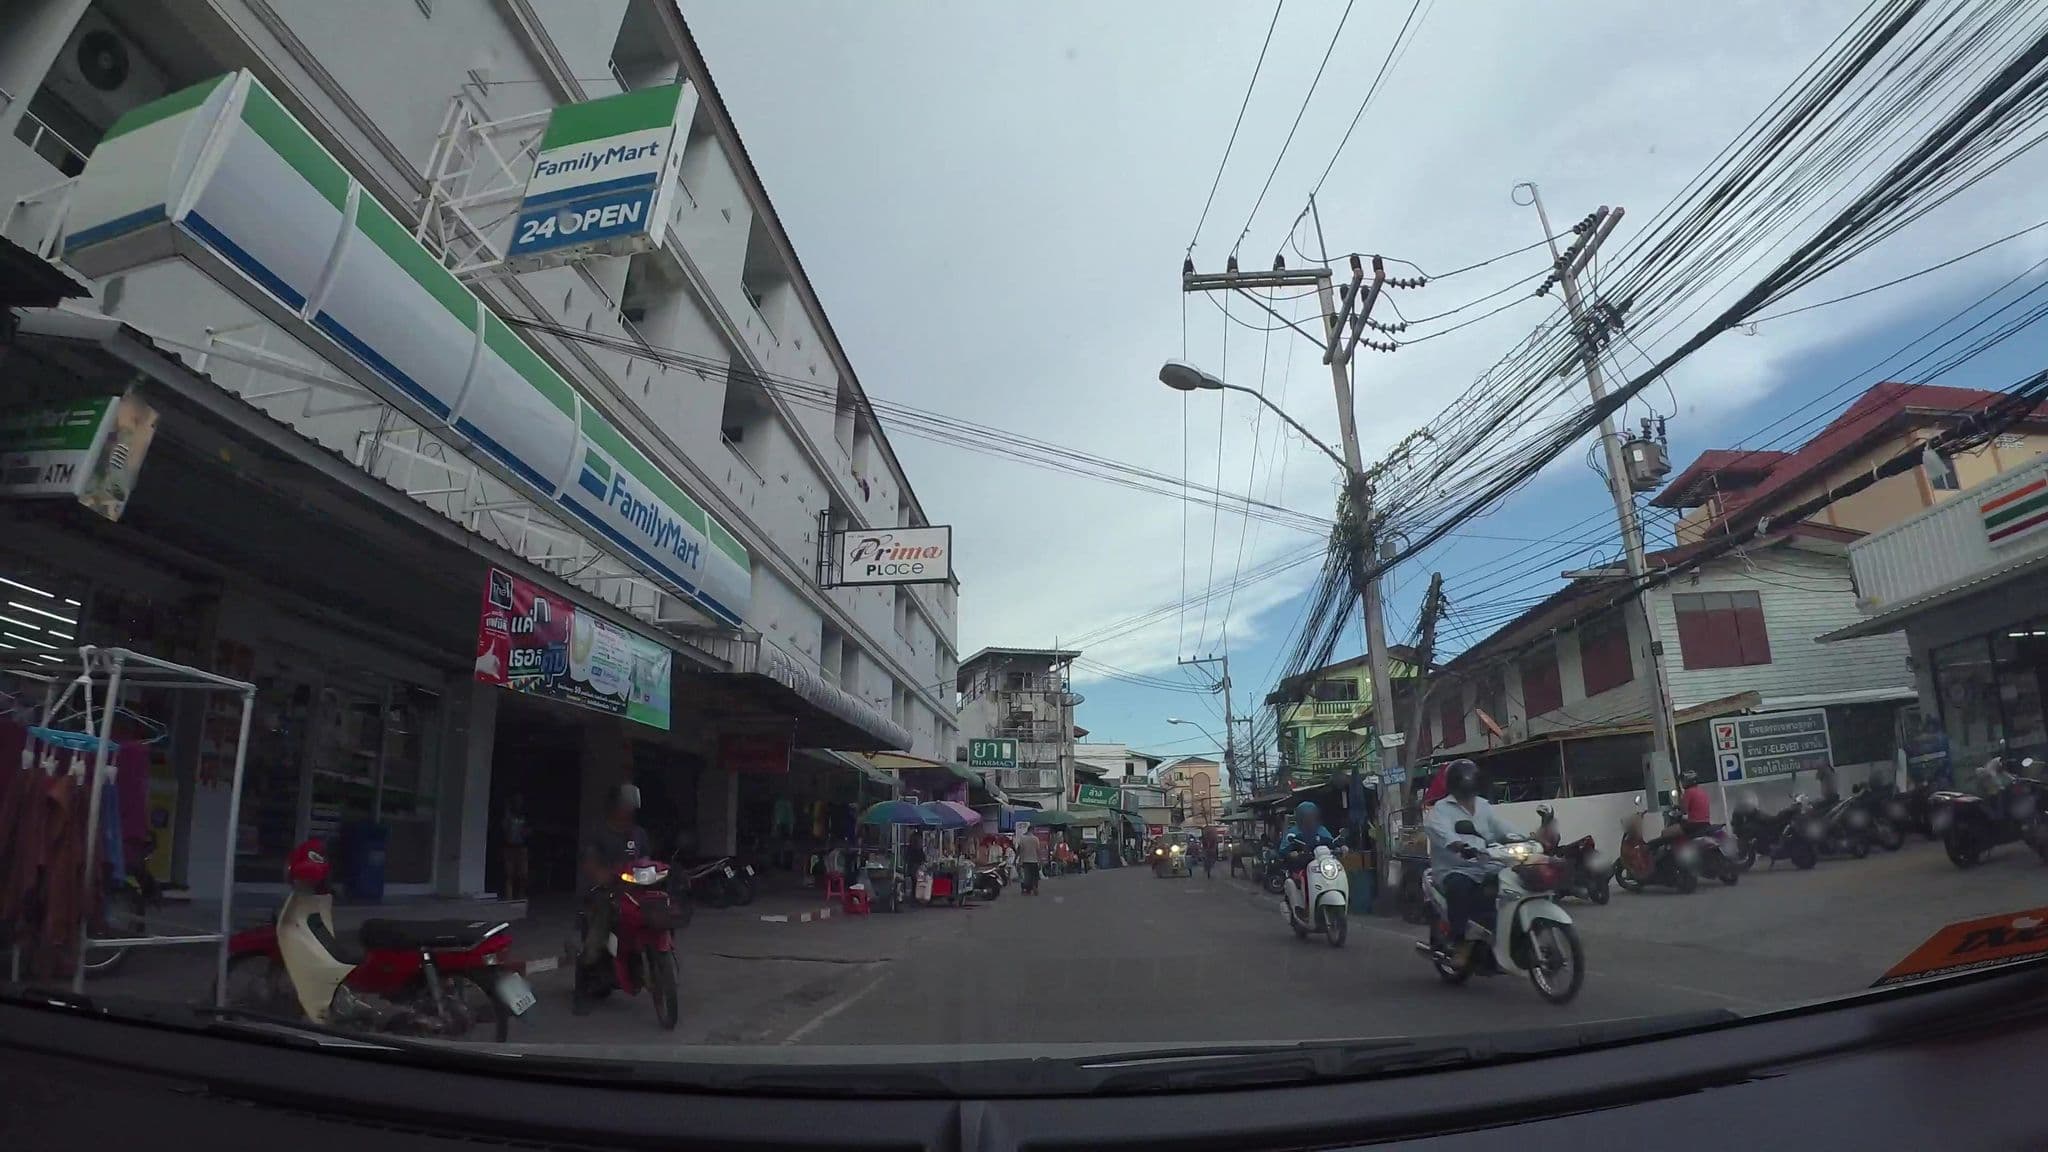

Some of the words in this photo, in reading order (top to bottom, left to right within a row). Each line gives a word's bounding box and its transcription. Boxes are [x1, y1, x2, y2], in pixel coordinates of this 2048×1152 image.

[534, 140, 659, 179] FamilyMart
[518, 215, 556, 244] 24
[558, 201, 641, 235] OPEN
[44, 463, 75, 484] ATM
[608, 471, 700, 569] FamilyMart
[849, 533, 944, 566] Prima
[972, 759, 1015, 767] PHARMACY
[974, 742, 998, 758] ยา
